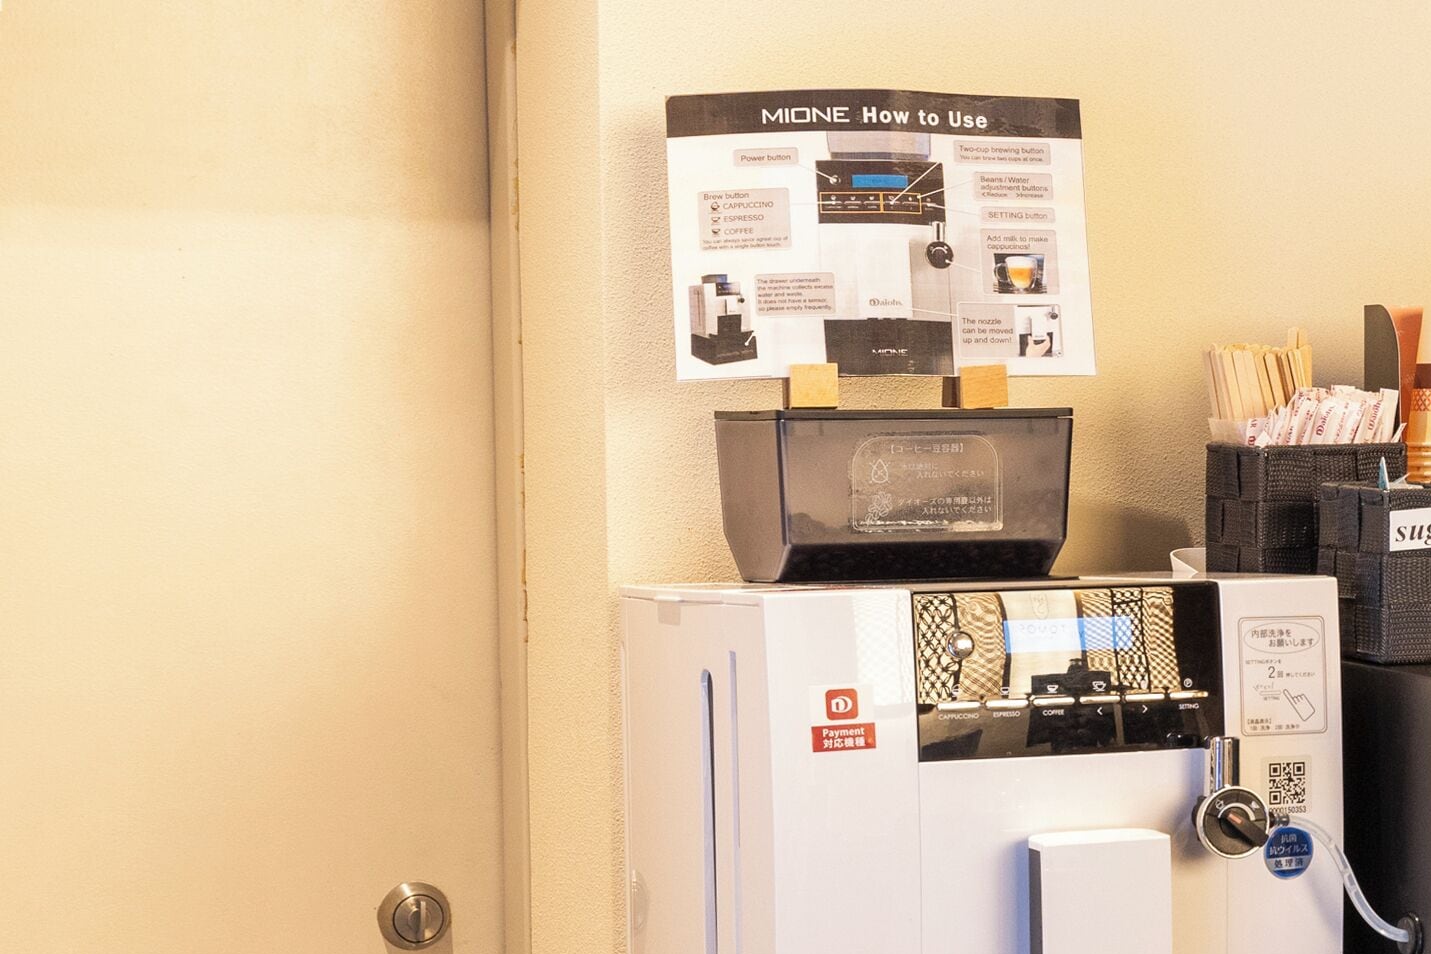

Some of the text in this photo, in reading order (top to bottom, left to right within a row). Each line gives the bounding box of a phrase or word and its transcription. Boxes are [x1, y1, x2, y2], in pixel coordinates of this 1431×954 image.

[761, 106, 988, 128] MIONE How to Use
[959, 145, 990, 153] Two-cup
[991, 146, 1020, 154] brewing
[740, 154, 765, 162] Power
[980, 184, 1020, 192] adjustment
[724, 192, 750, 200] button
[722, 201, 774, 210] CAPPUCCINO
[723, 214, 764, 222] ESPRESSO
[1025, 212, 1048, 220] button
[724, 228, 754, 236] COFFEE
[974, 336, 988, 344] and
[990, 336, 1012, 344] down!
[1251, 628, 1292, 639] 内部洗浄を
[1268, 638, 1314, 648] お願いします
[1178, 702, 1200, 710] SETTING
[938, 712, 980, 720] CAPPUCCINO
[992, 710, 1021, 718] ESPRESSO
[1042, 708, 1065, 716] COFFEE
[822, 728, 864, 738] Payment
[823, 736, 866, 748] 対応機種
[1270, 844, 1308, 855] 抗ウイルス
